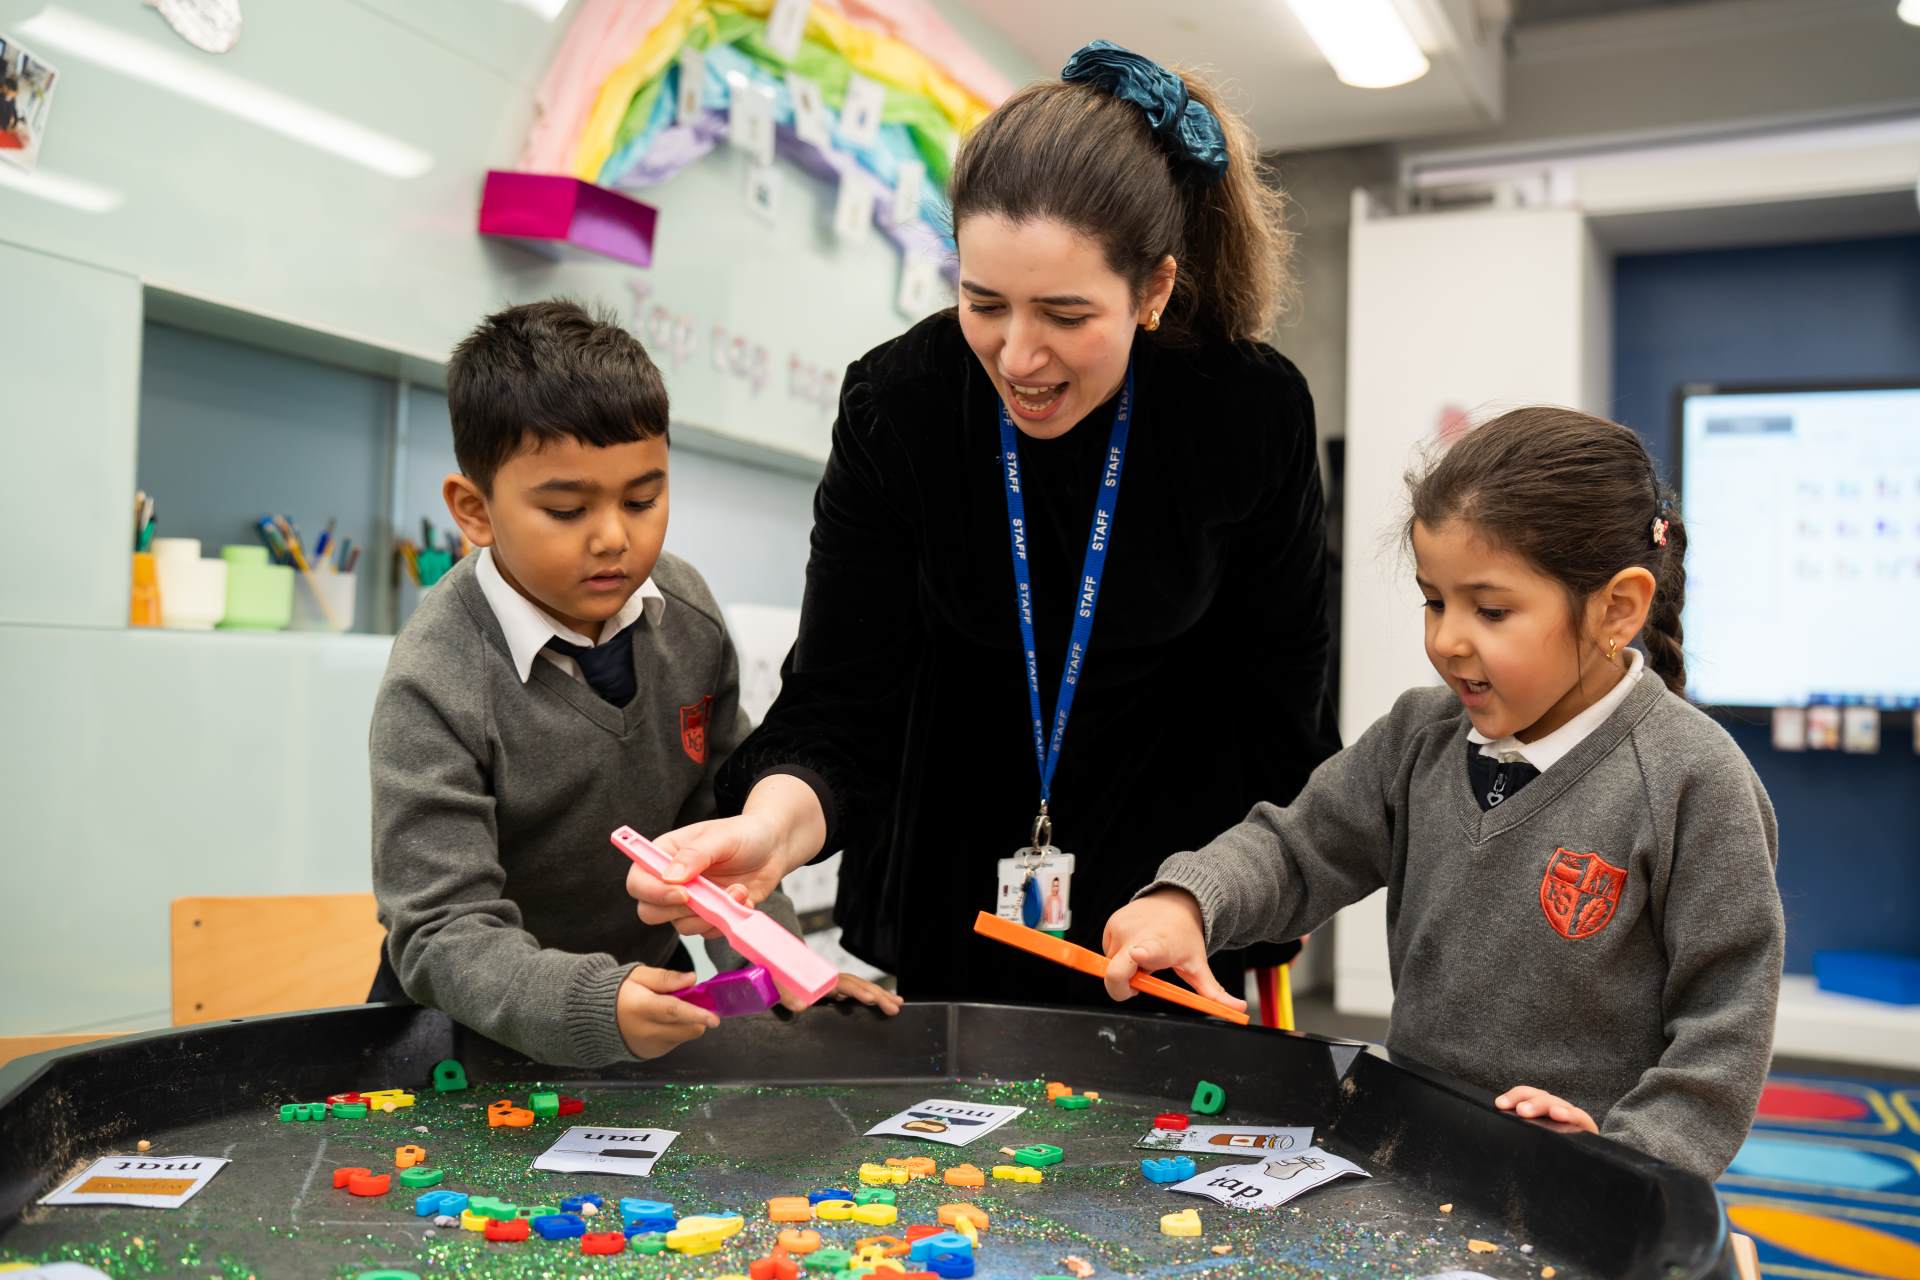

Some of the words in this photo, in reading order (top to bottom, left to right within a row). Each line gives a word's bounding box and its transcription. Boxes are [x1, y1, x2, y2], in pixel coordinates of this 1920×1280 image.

[1006, 451, 1020, 494] STAFF
[1012, 518, 1026, 560] STAFF
[1019, 582, 1031, 625] STAFF
[1052, 709, 1066, 752] STAFF
[1066, 642, 1083, 684] STAFF
[1079, 575, 1097, 617] STAFF
[1092, 509, 1109, 551] STAFF
[1105, 446, 1121, 487] STAFF
[1027, 650, 1039, 692] STAFF
[1035, 719, 1045, 761] STAFF
[924, 1105, 995, 1118] man
[583, 1133, 652, 1142] pan
[113, 1161, 203, 1171] mat
[1206, 1176, 1264, 1199] tap
